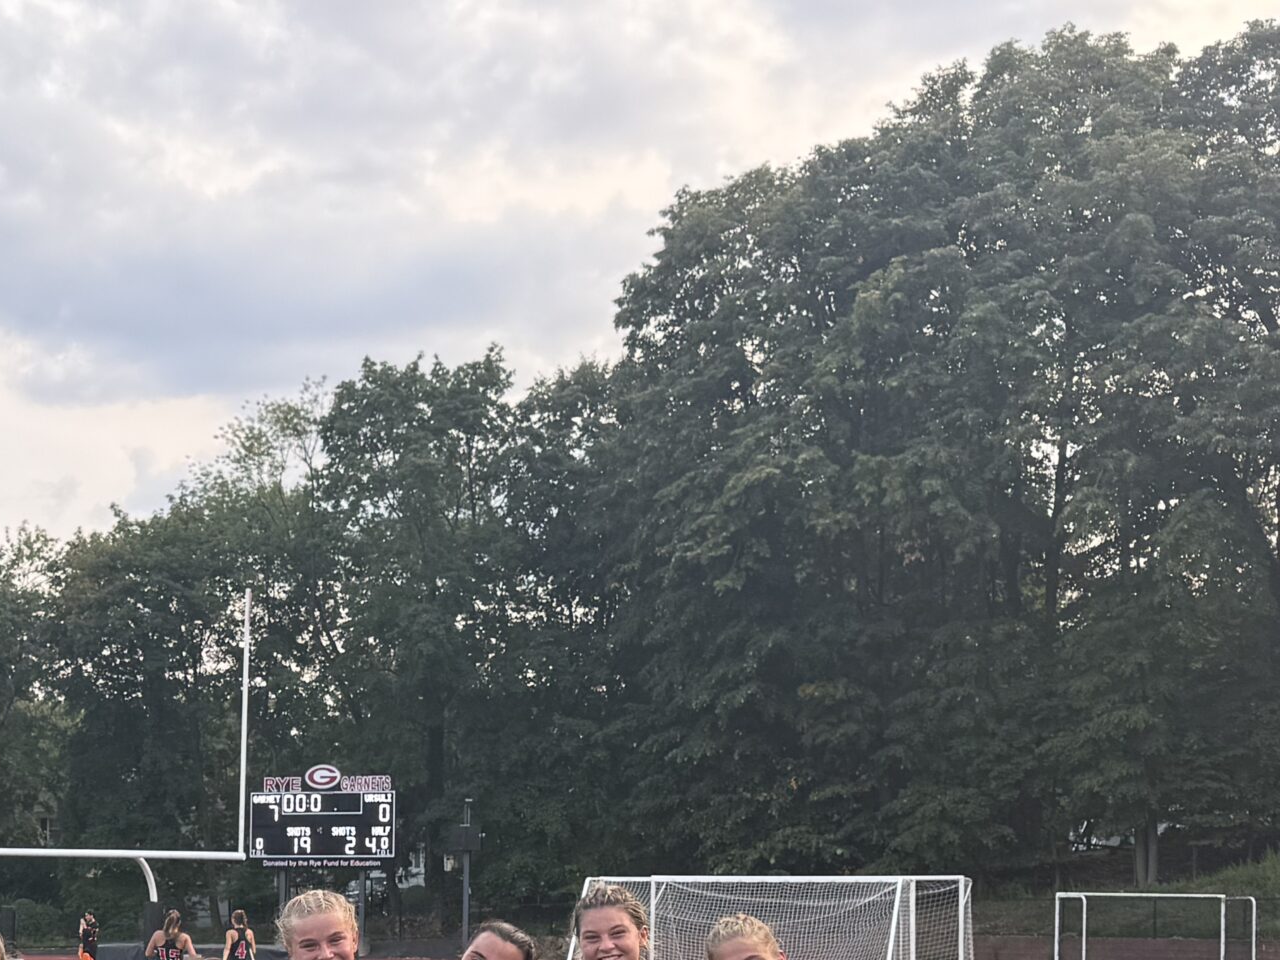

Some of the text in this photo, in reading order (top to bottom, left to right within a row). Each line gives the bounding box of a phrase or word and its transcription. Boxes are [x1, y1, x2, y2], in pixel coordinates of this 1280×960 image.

[263, 776, 302, 792] RYE
[306, 765, 340, 788] G
[341, 775, 392, 791] GARNETS
[268, 804, 279, 822] 7
[378, 803, 390, 822] 0
[286, 826, 311, 837] SHOTS
[331, 826, 356, 837] SHOTS
[255, 837, 264, 850] 0
[293, 836, 311, 854] 19
[344, 836, 356, 855] 2
[289, 860, 297, 868] by
[309, 860, 322, 868] Rye
[234, 940, 247, 960] 4
